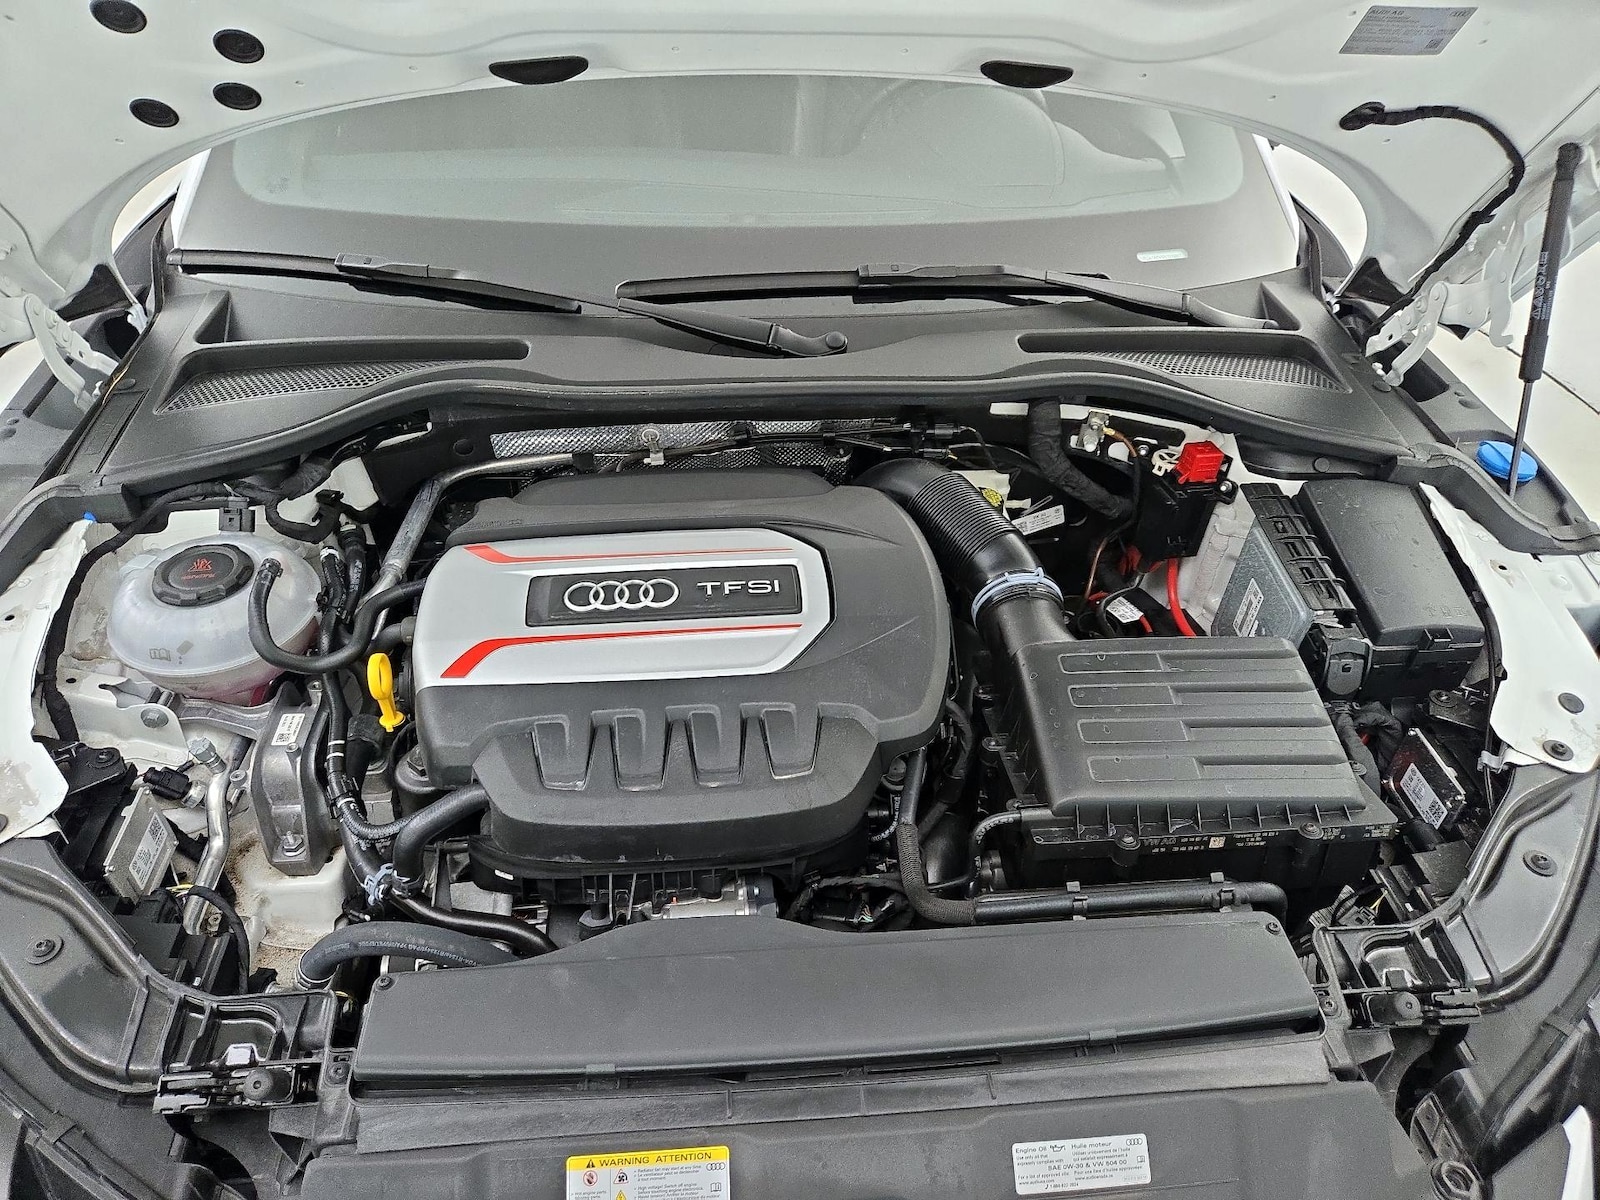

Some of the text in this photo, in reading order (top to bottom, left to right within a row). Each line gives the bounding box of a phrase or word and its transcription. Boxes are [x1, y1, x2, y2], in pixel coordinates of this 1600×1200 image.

[697, 580, 780, 596] TFSI
[600, 1152, 712, 1166] WARNING ATTENTION
